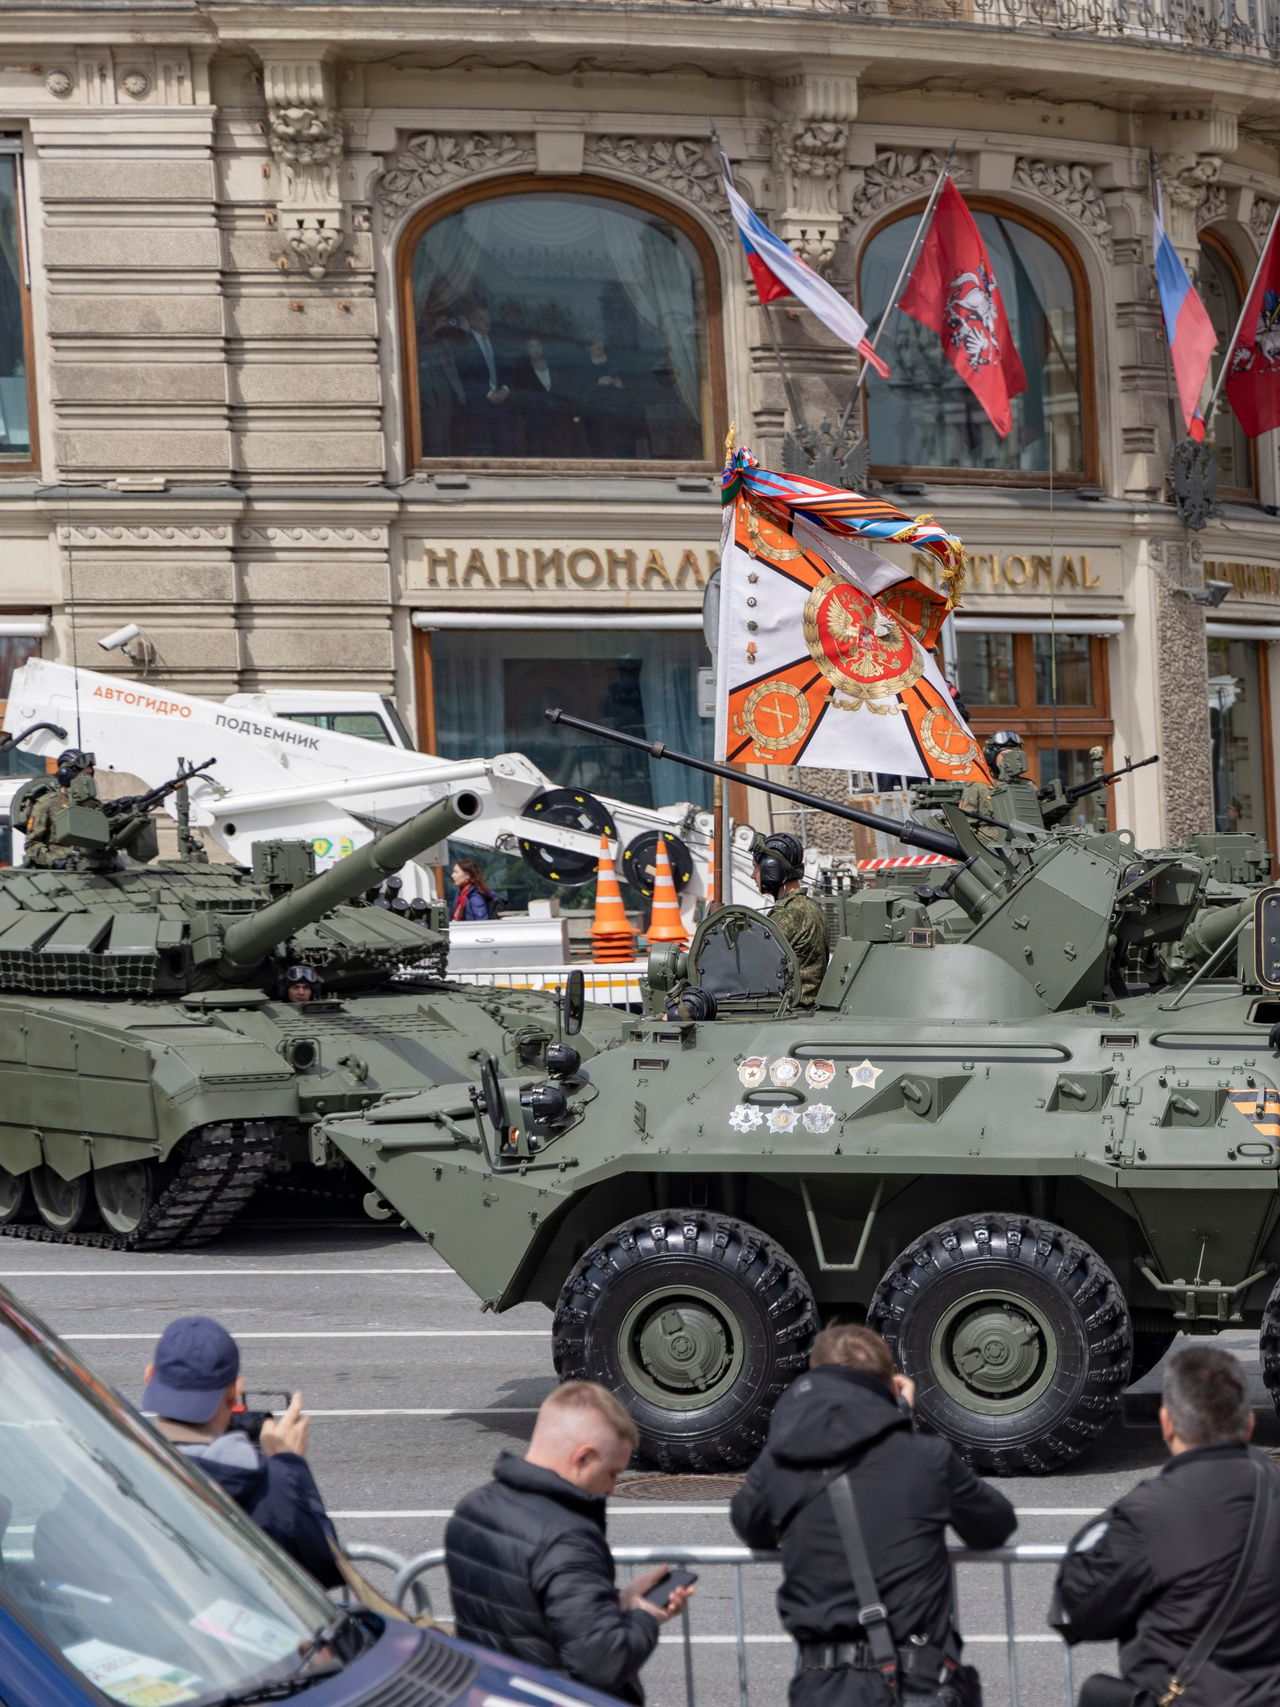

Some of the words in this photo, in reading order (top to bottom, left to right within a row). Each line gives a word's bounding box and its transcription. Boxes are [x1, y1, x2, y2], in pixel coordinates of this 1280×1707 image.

[911, 552, 1100, 588] NTIONAL
[93, 685, 192, 718] АВТОГИДРО
[215, 714, 320, 750] ПОДЪЕМНИК
